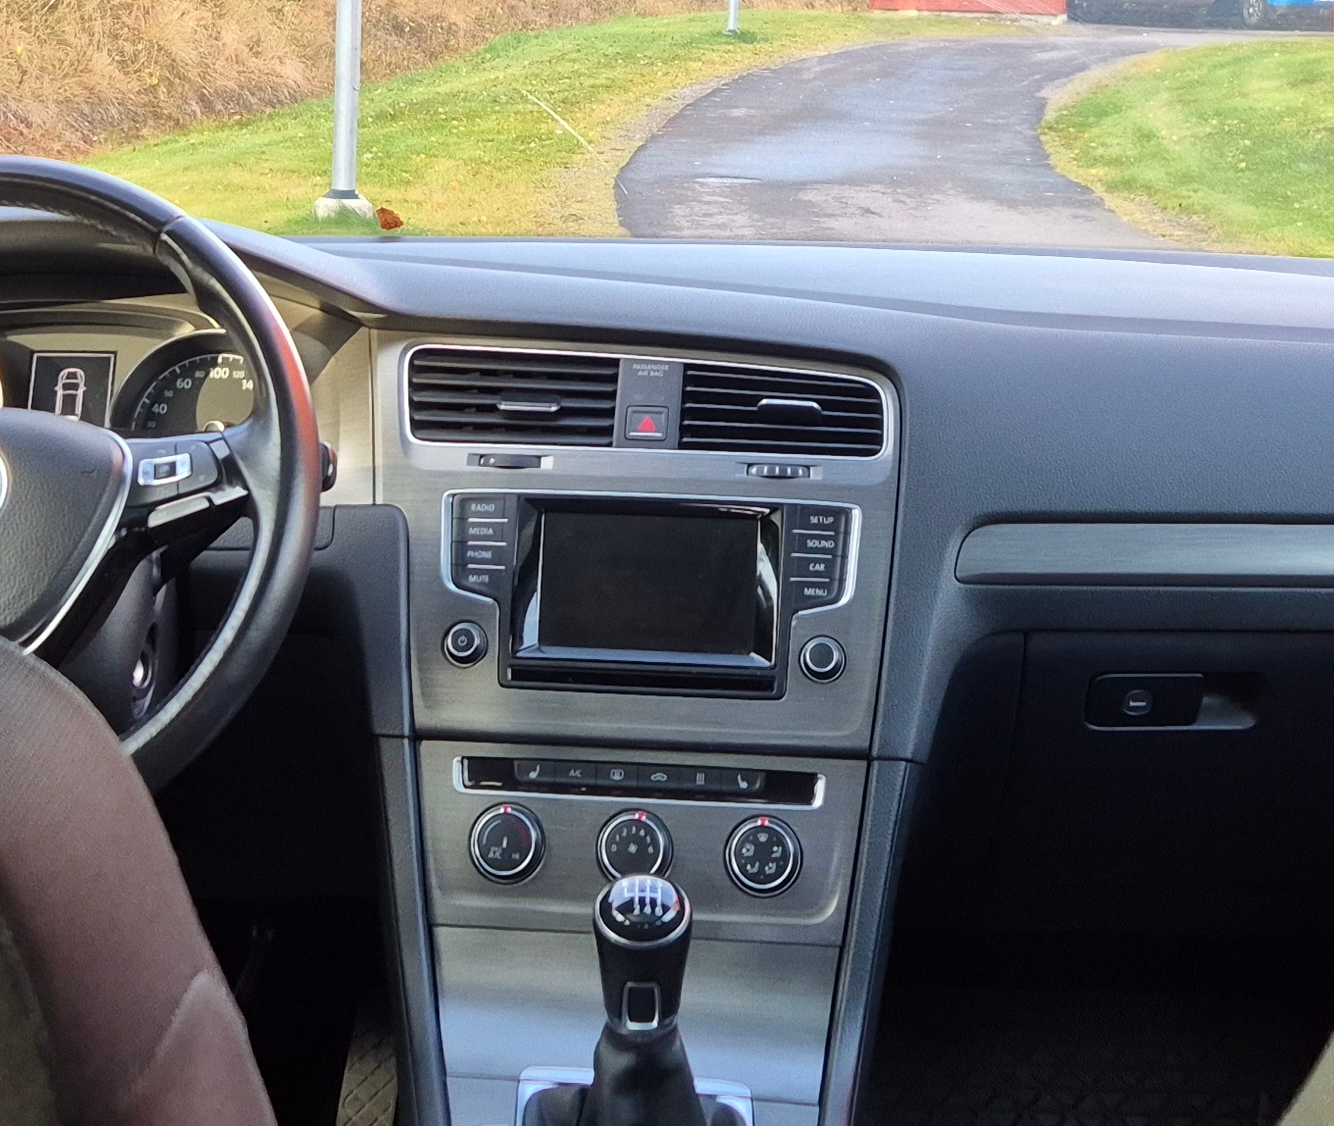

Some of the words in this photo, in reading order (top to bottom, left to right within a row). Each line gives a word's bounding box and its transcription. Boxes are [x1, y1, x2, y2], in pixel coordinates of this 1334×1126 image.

[152, 404, 167, 414] 40
[176, 378, 192, 389] 60
[209, 367, 230, 379] 100
[470, 503, 495, 512] RADIO
[810, 515, 835, 525] SETUP
[468, 527, 494, 535] MEDIA
[807, 539, 835, 548] SOUND
[467, 550, 493, 559] PHONE
[809, 562, 826, 572] CAR
[468, 574, 489, 583] MUTE
[803, 587, 828, 596] MENU
